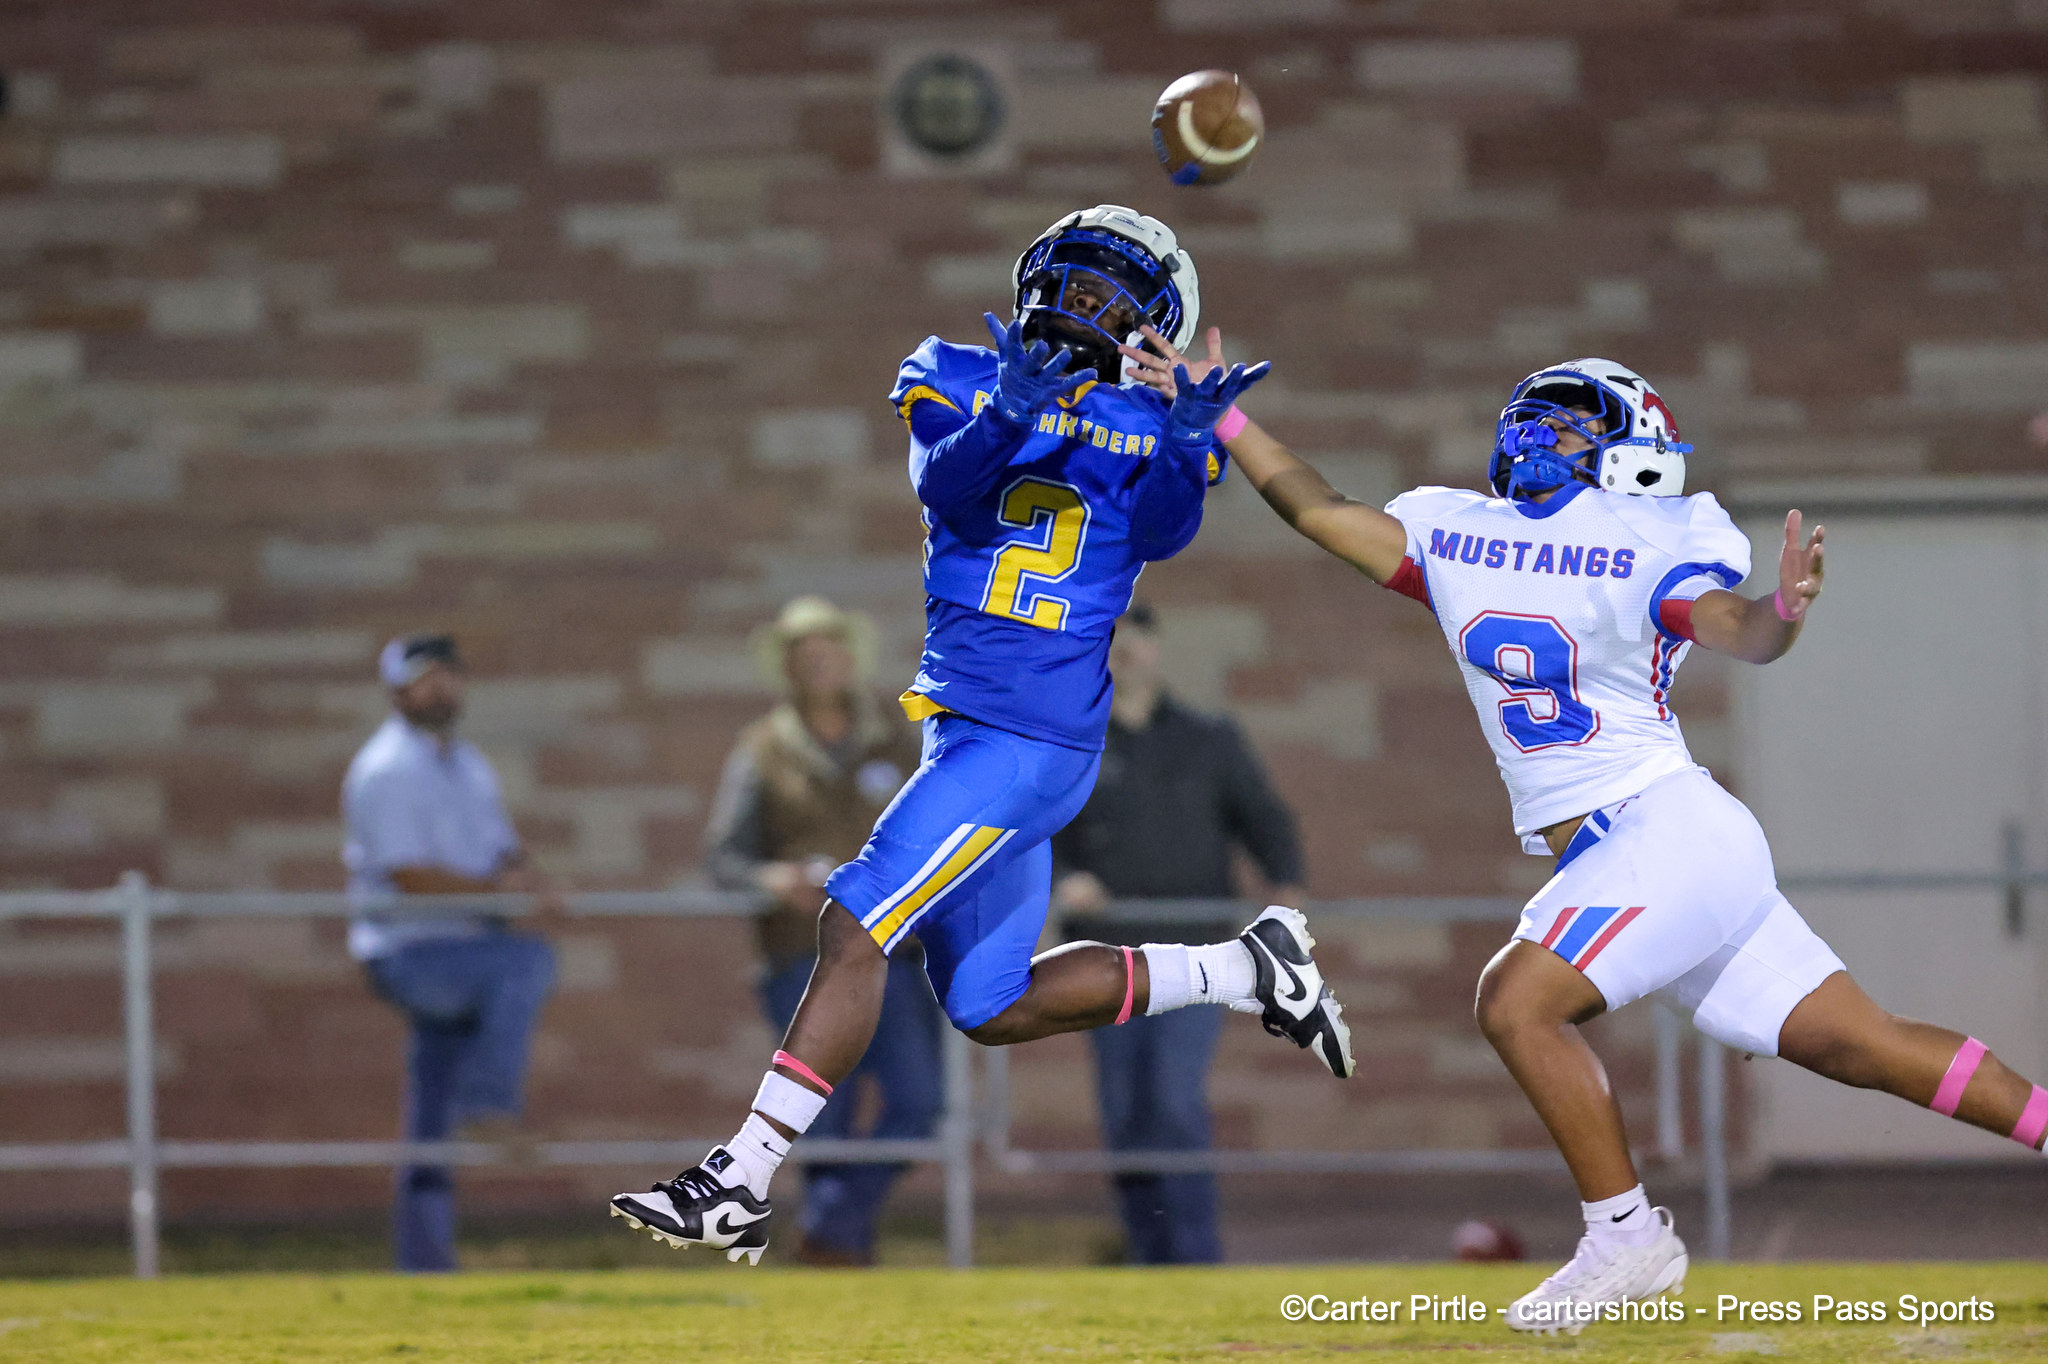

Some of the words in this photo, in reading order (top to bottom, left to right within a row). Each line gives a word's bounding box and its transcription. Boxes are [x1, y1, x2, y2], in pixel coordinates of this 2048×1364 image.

[978, 475, 1092, 631] 2
[1429, 528, 1635, 579] MUSTANGS
[1459, 610, 1600, 754] 9
